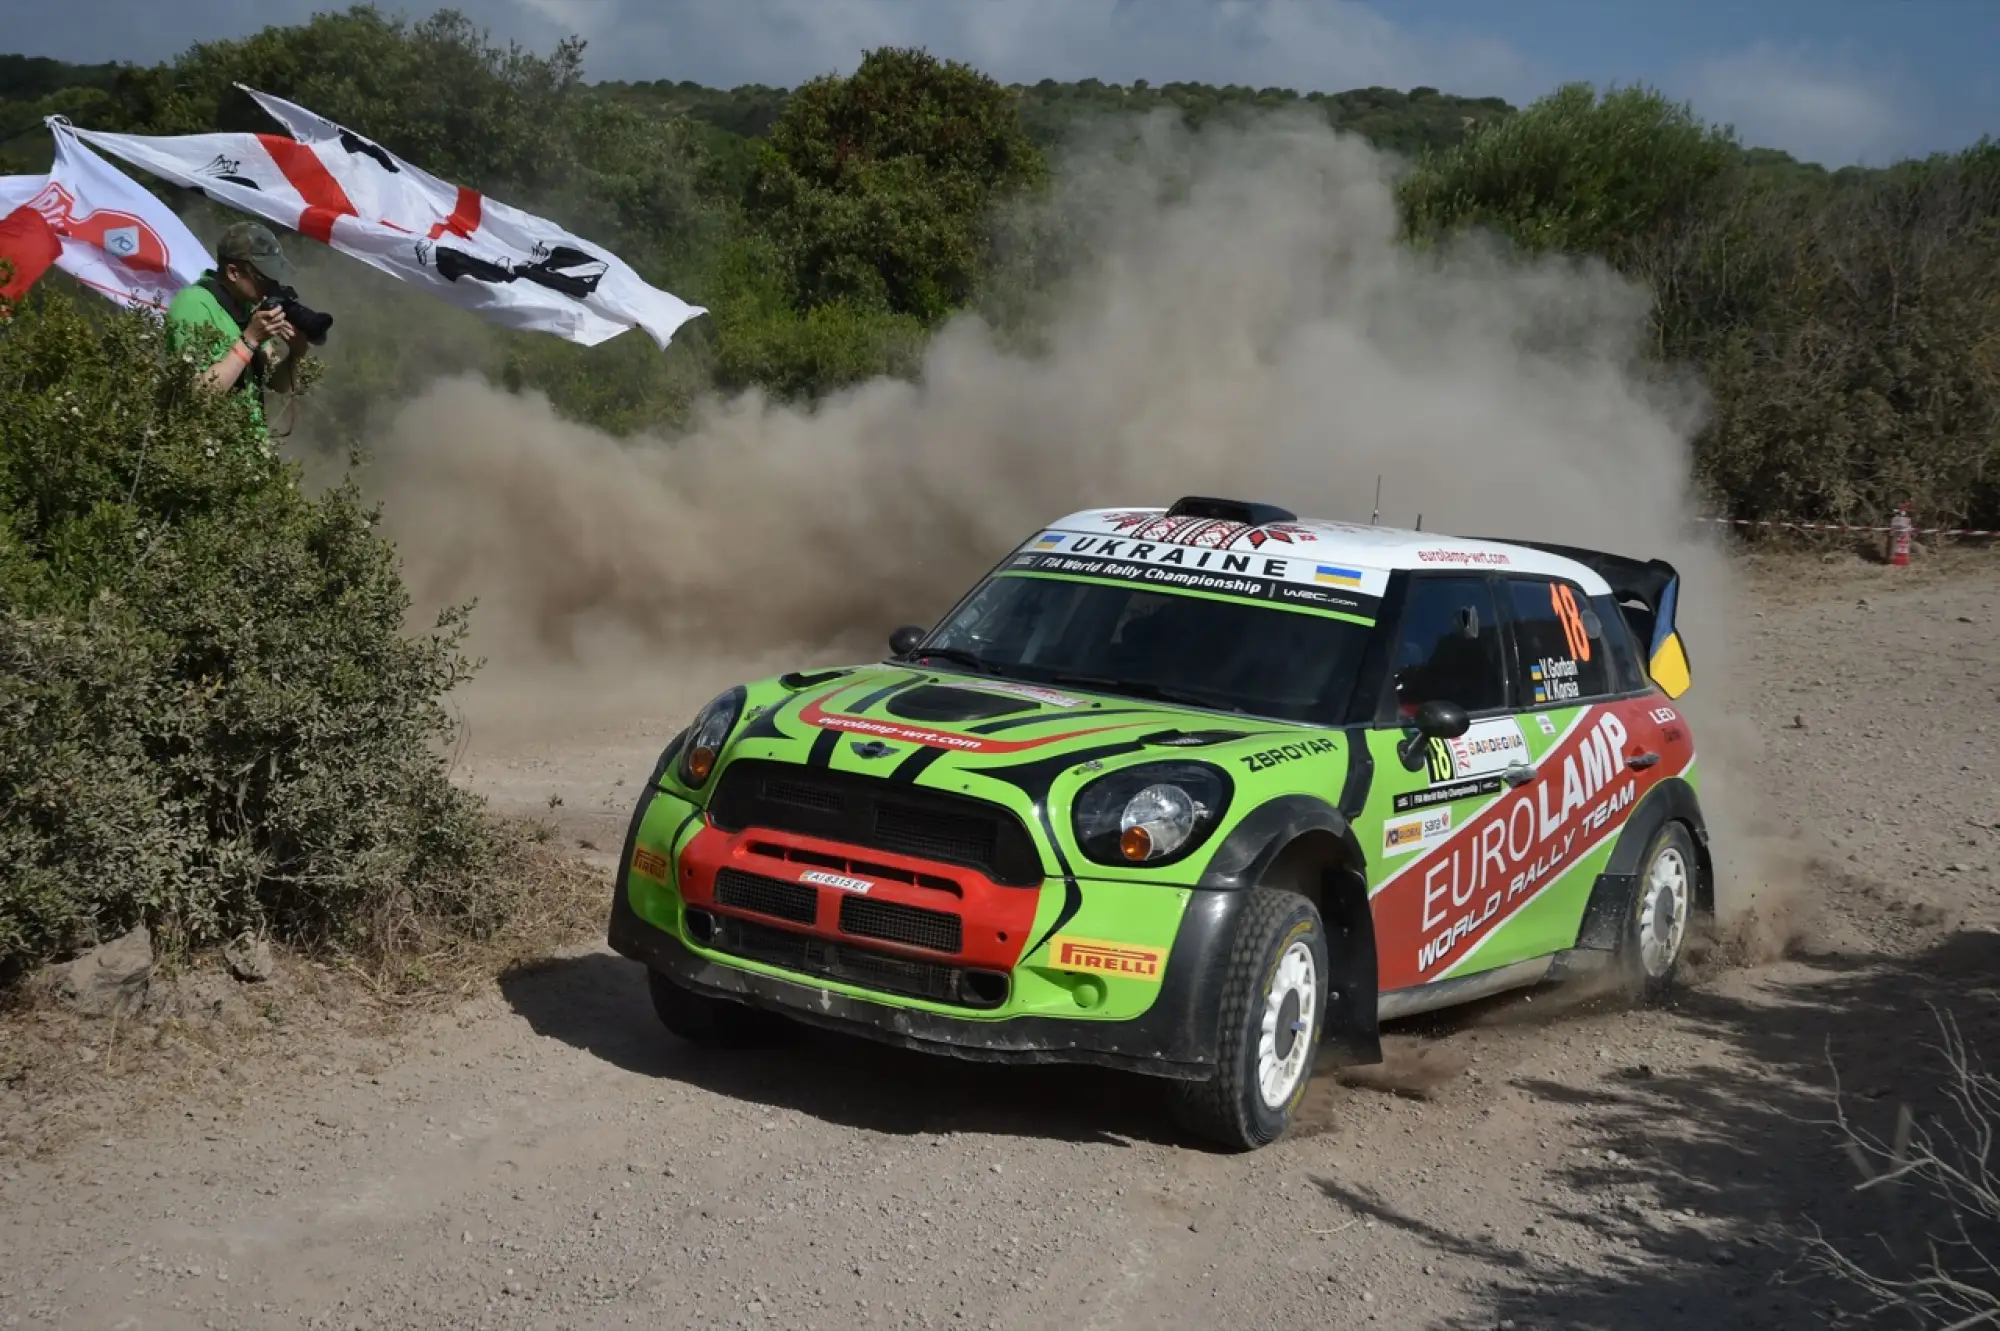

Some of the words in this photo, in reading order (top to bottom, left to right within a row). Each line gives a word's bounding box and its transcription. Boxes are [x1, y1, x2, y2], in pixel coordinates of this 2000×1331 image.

[1070, 536, 1288, 578] UKRAINE
[1418, 549, 1510, 566] eurolamp-wrt.com
[1042, 557, 1063, 569] FIA
[1062, 558, 1102, 573] World
[1103, 562, 1142, 579] Rally
[1145, 567, 1262, 594] Championship
[1549, 582, 1590, 662] 18
[818, 717, 983, 749] eurolamp-wrt.com
[1649, 707, 1677, 724] LED
[1240, 738, 1338, 773] ZBROYAR
[1427, 737, 1453, 781] 18
[1469, 733, 1524, 756] SARDEGNA
[1418, 890, 1502, 973] WORLD
[1508, 828, 1577, 902] RALLY
[1582, 779, 1636, 838] TEAM
[1061, 943, 1158, 975] PIRELLI
